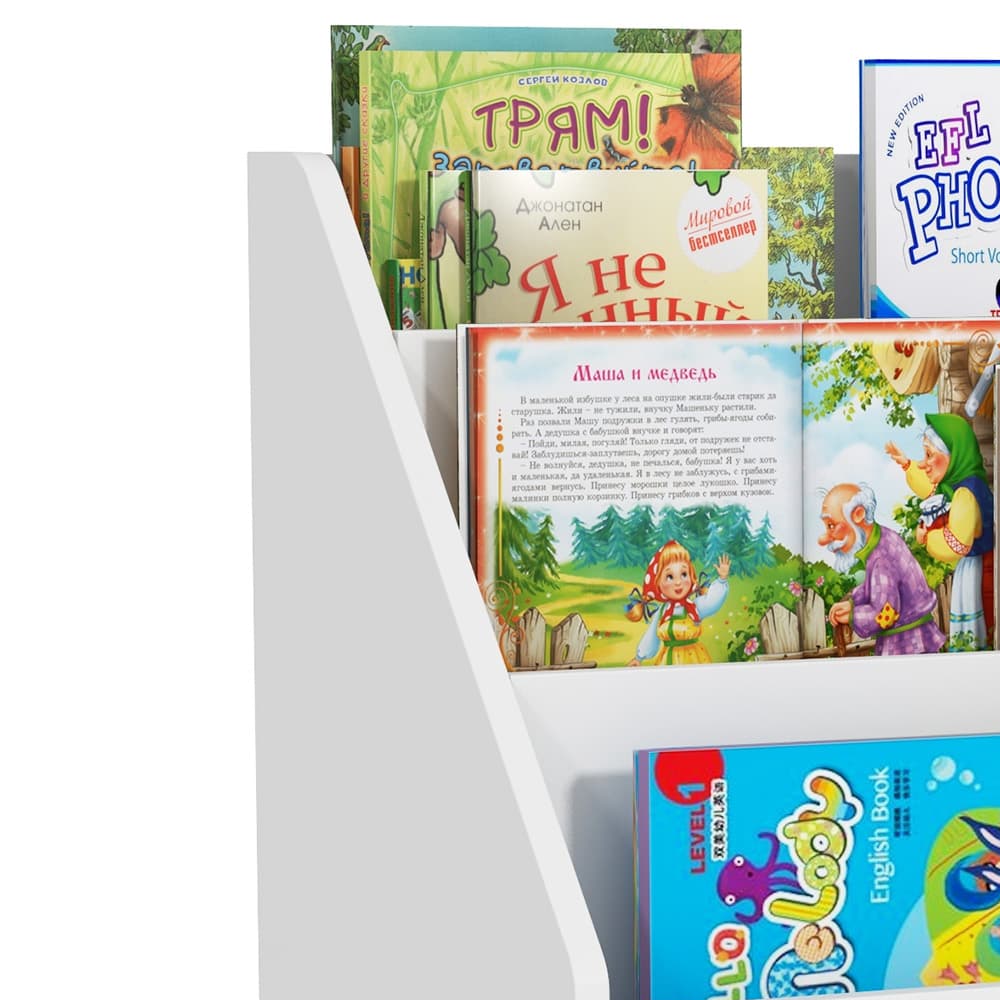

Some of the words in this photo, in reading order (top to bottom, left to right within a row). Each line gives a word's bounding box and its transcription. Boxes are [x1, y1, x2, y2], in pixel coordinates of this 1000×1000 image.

[562, 76, 608, 86] КОЗЛОВ
[475, 94, 650, 151] ТРЯМ!
[886, 129, 897, 157] NEW
[895, 94, 924, 128] EDITION
[914, 100, 991, 170] EFL
[516, 198, 603, 215] Джонатан
[538, 216, 582, 231] Ален
[684, 194, 752, 231] Мировой
[688, 219, 757, 252] бестселлер
[951, 248, 984, 264] Short
[519, 254, 572, 323] Я
[587, 253, 666, 296] не
[573, 365, 625, 382] Маша
[632, 369, 641, 380] и
[648, 368, 717, 383] медведь
[678, 783, 705, 798] 1
[869, 767, 890, 822] Book
[690, 799, 706, 874] LEVEL
[869, 827, 895, 903] English
